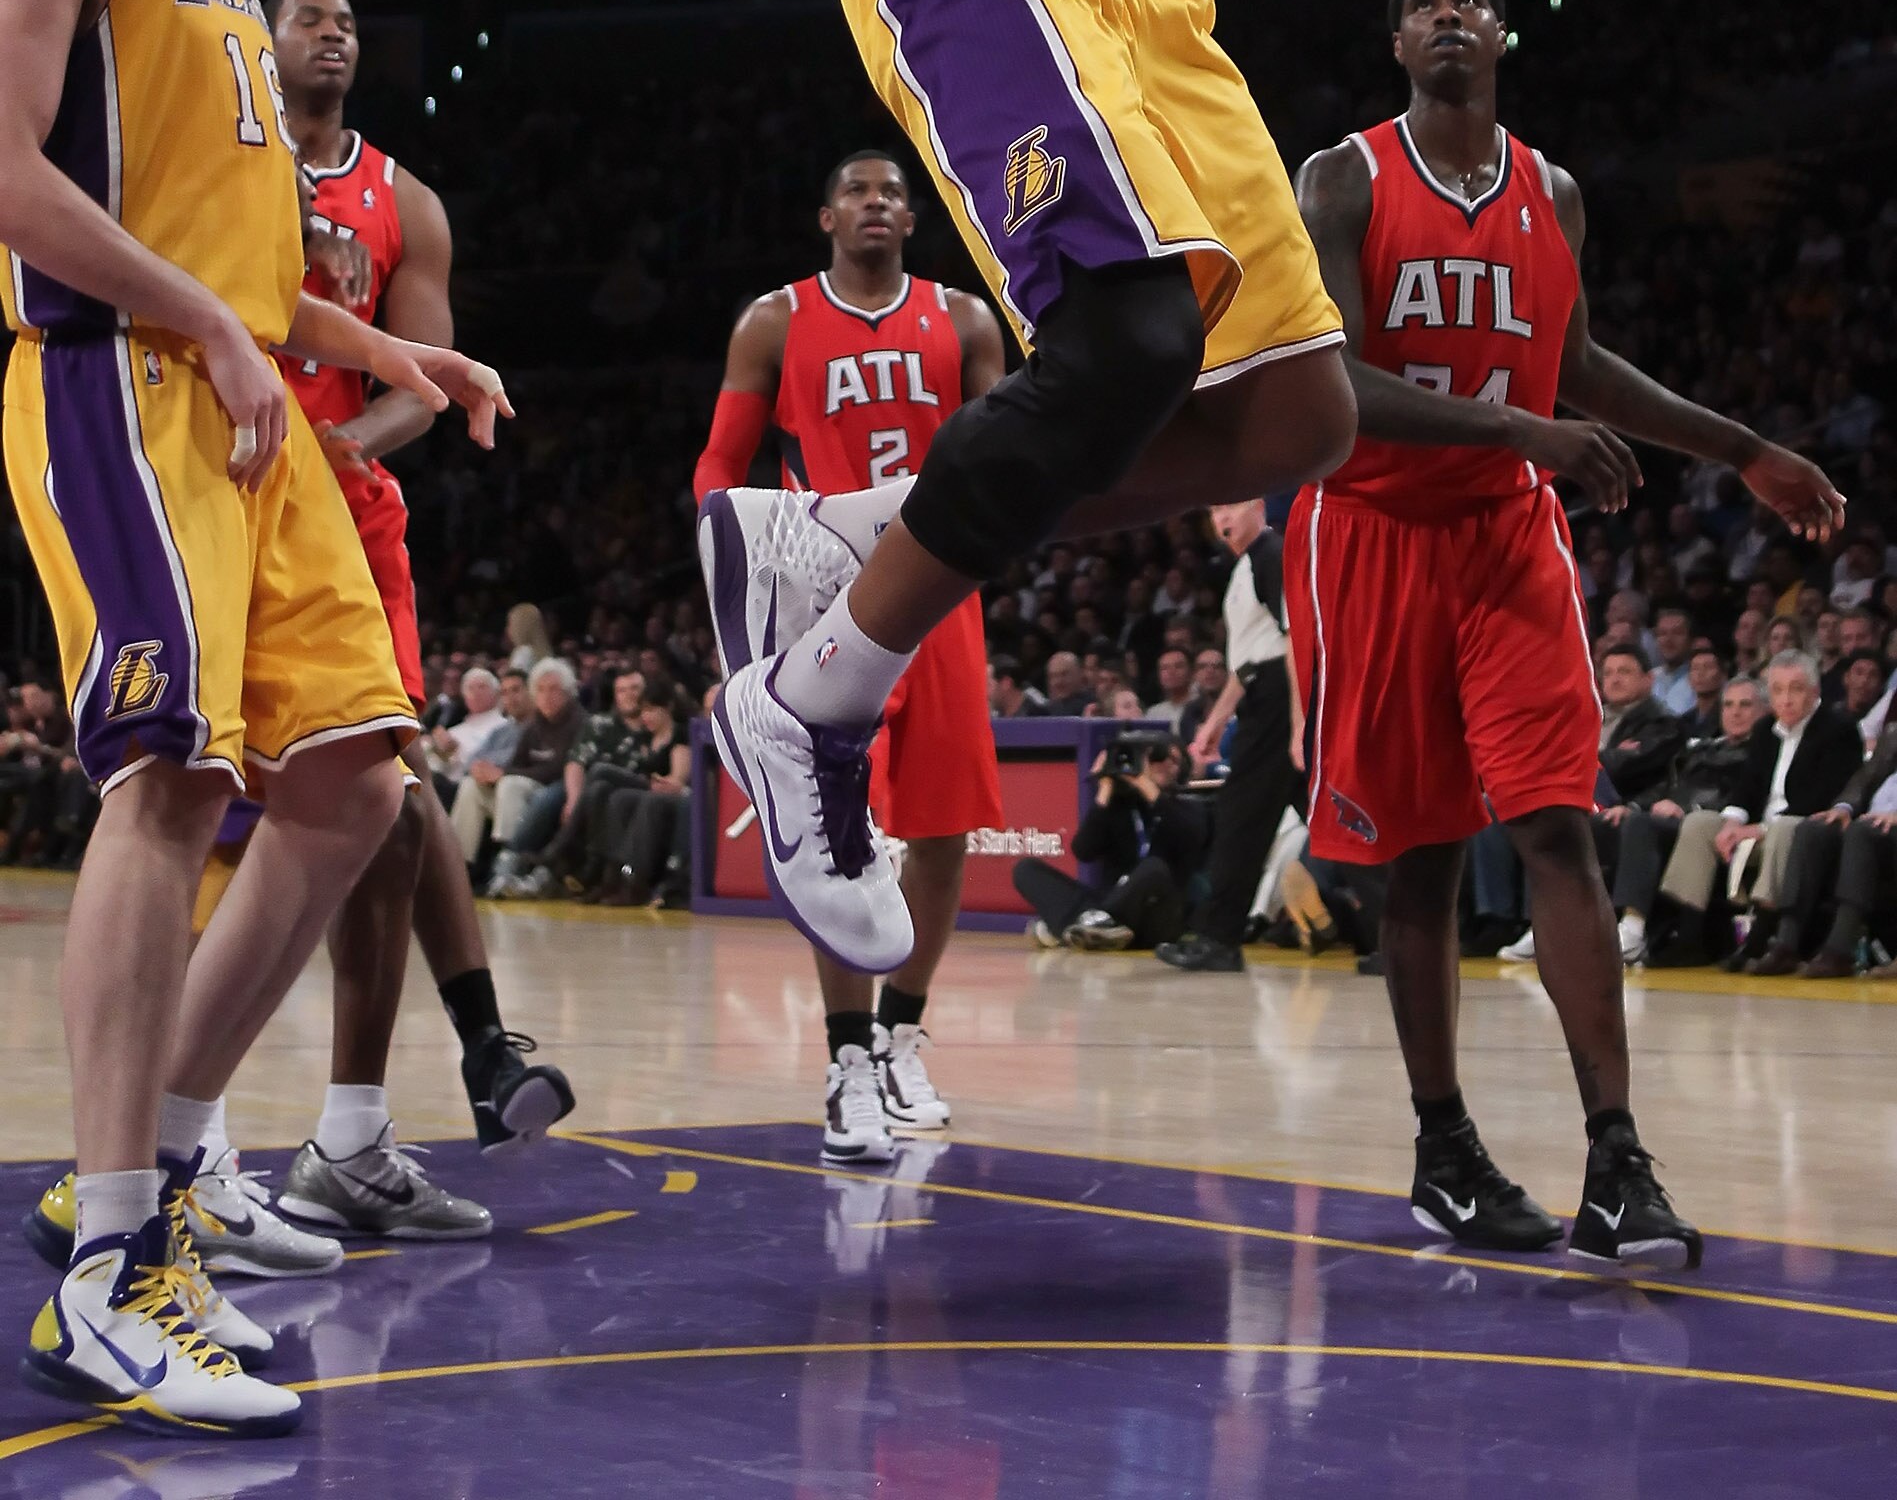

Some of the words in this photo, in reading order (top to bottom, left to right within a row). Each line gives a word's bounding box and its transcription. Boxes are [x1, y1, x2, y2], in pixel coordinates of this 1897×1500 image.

[1384, 257, 1533, 340] ATL
[825, 348, 940, 417] ATL
[869, 426, 909, 488] 2
